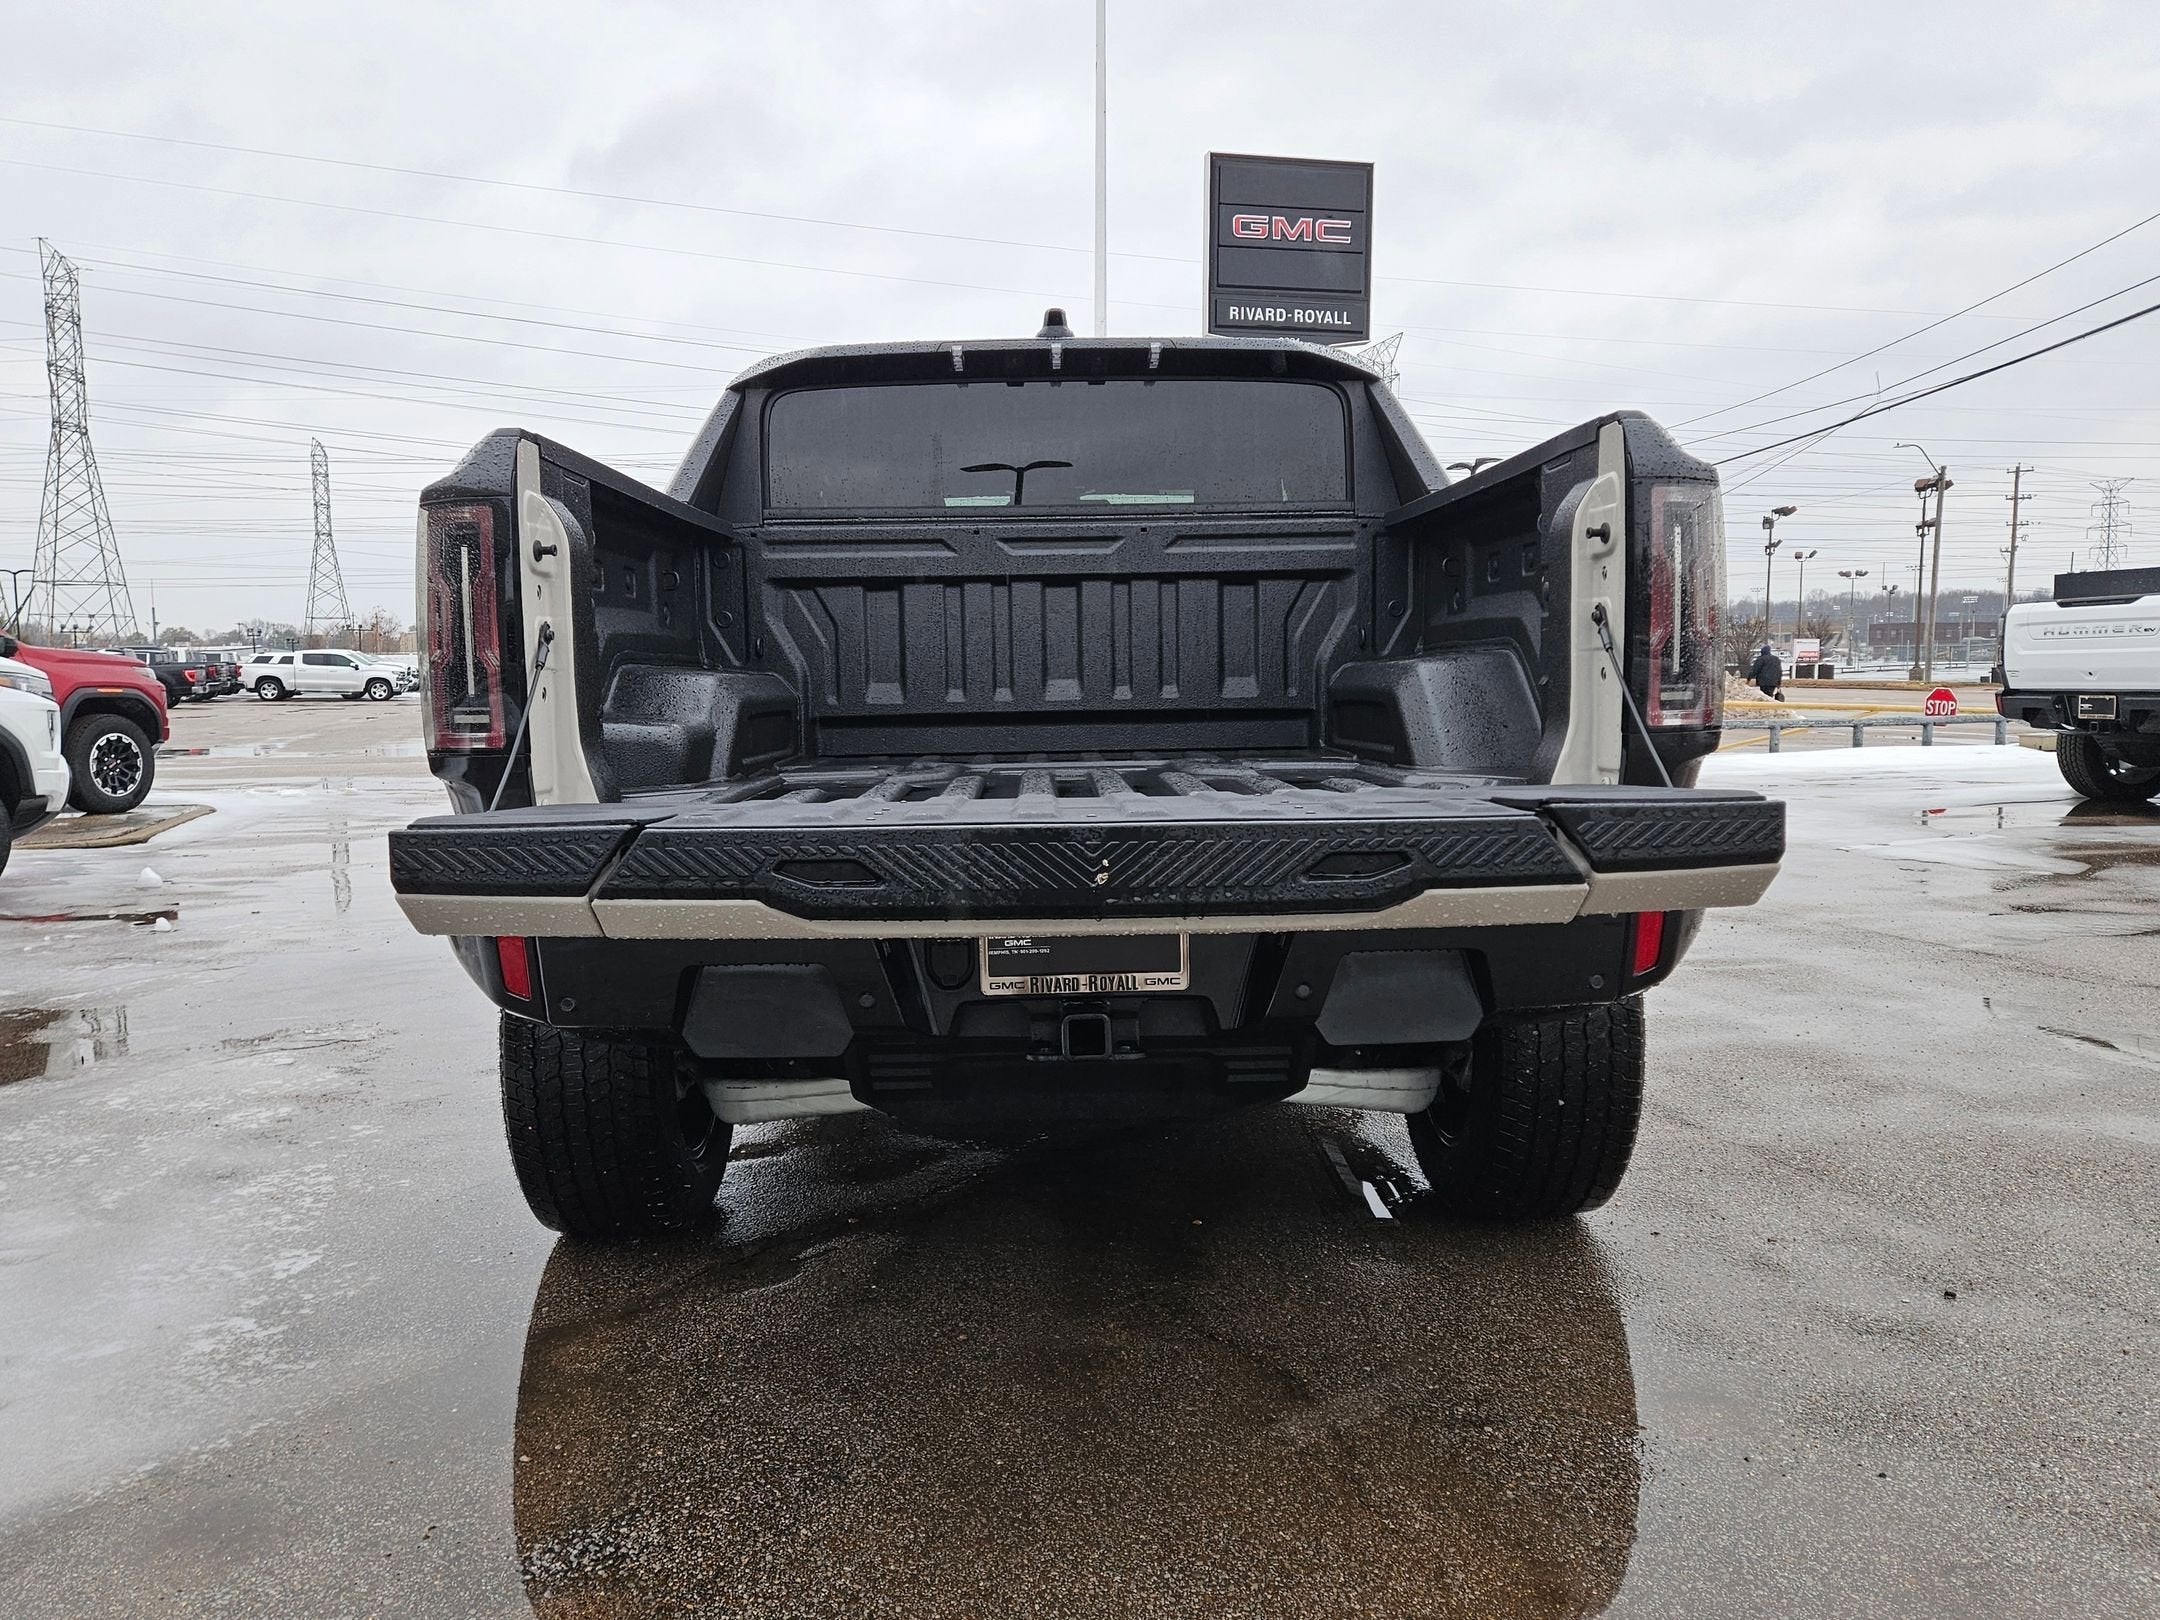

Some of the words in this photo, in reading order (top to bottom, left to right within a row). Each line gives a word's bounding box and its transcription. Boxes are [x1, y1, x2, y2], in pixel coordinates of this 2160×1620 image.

[1232, 214, 1352, 244] GMC
[1229, 306, 1352, 325] RIVARD-ROYALL
[1926, 699, 1956, 715] STOP
[1004, 939, 1032, 947] GMC
[989, 981, 1025, 990] GMC
[1029, 975, 1139, 993] RIVARD-ROYALL
[1145, 977, 1182, 986] GMC
